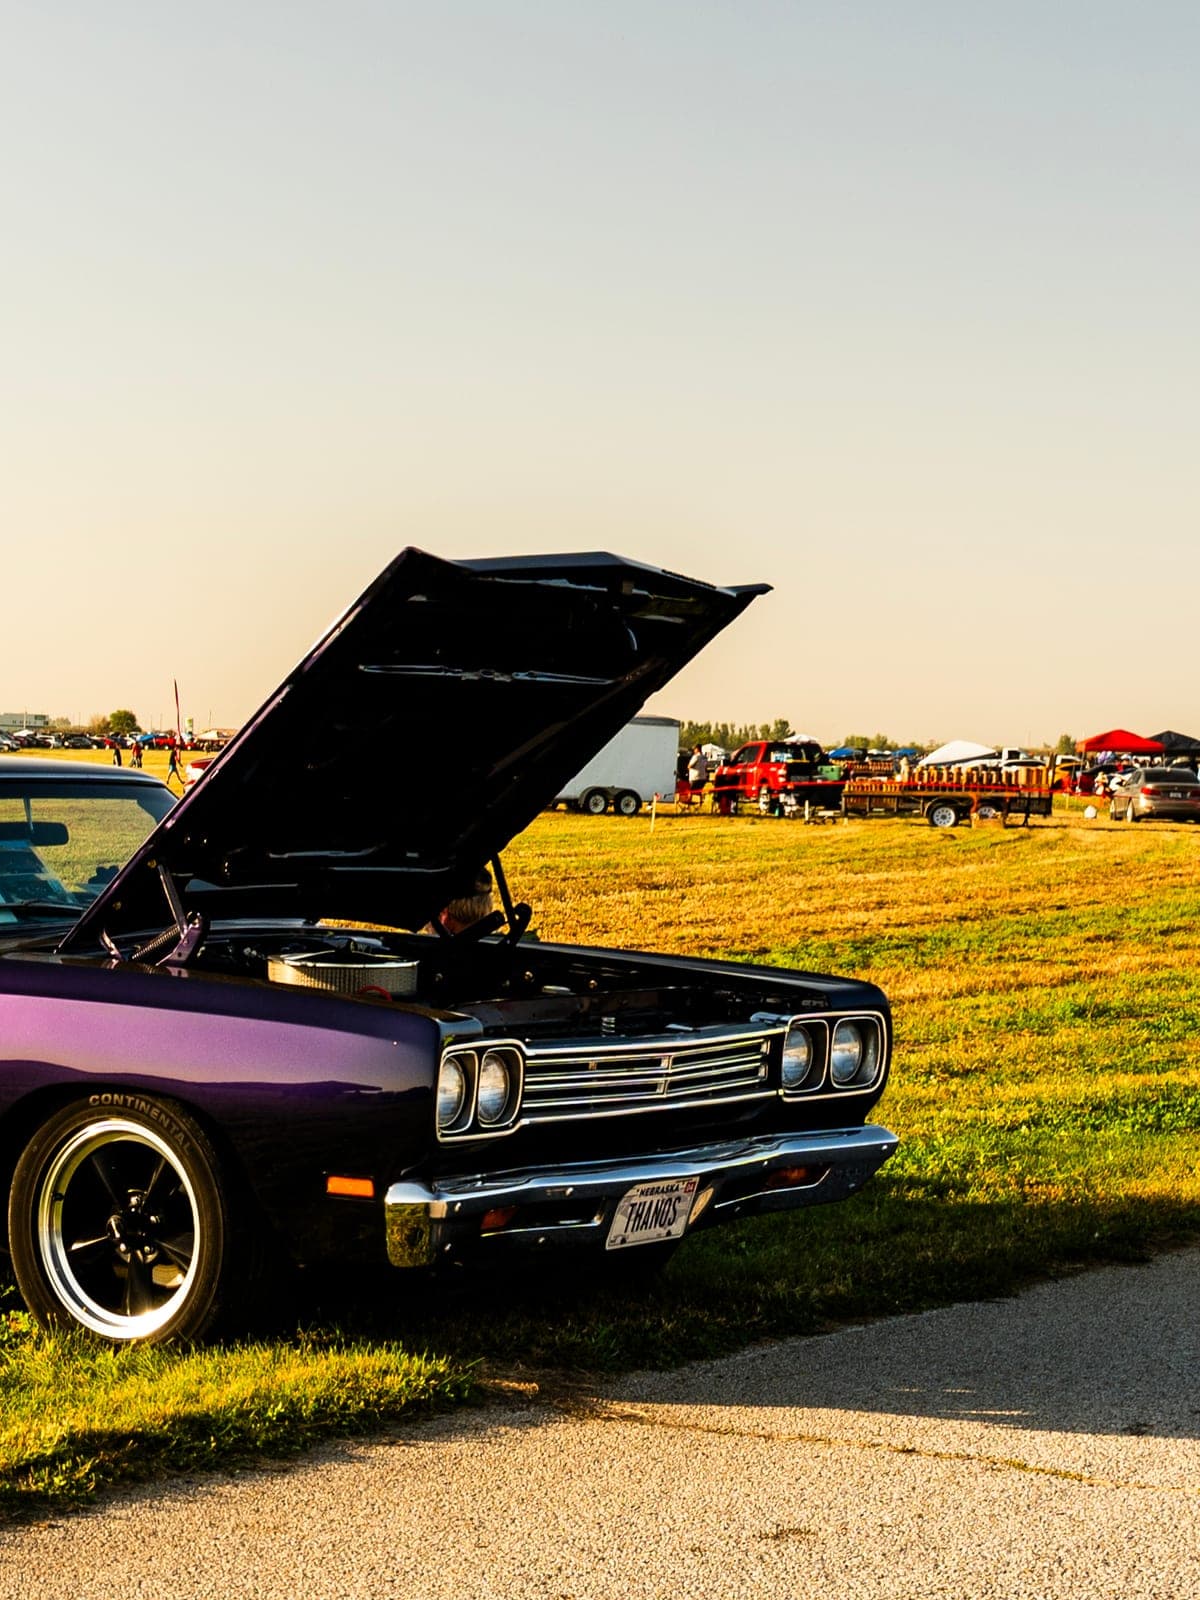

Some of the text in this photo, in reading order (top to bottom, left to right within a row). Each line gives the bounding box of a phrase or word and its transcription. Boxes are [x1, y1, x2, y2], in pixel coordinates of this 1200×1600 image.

[88, 1093, 191, 1155] CONTINENTAL
[639, 1184, 680, 1197] NEBRASKA
[624, 1197, 681, 1233] THANOS
